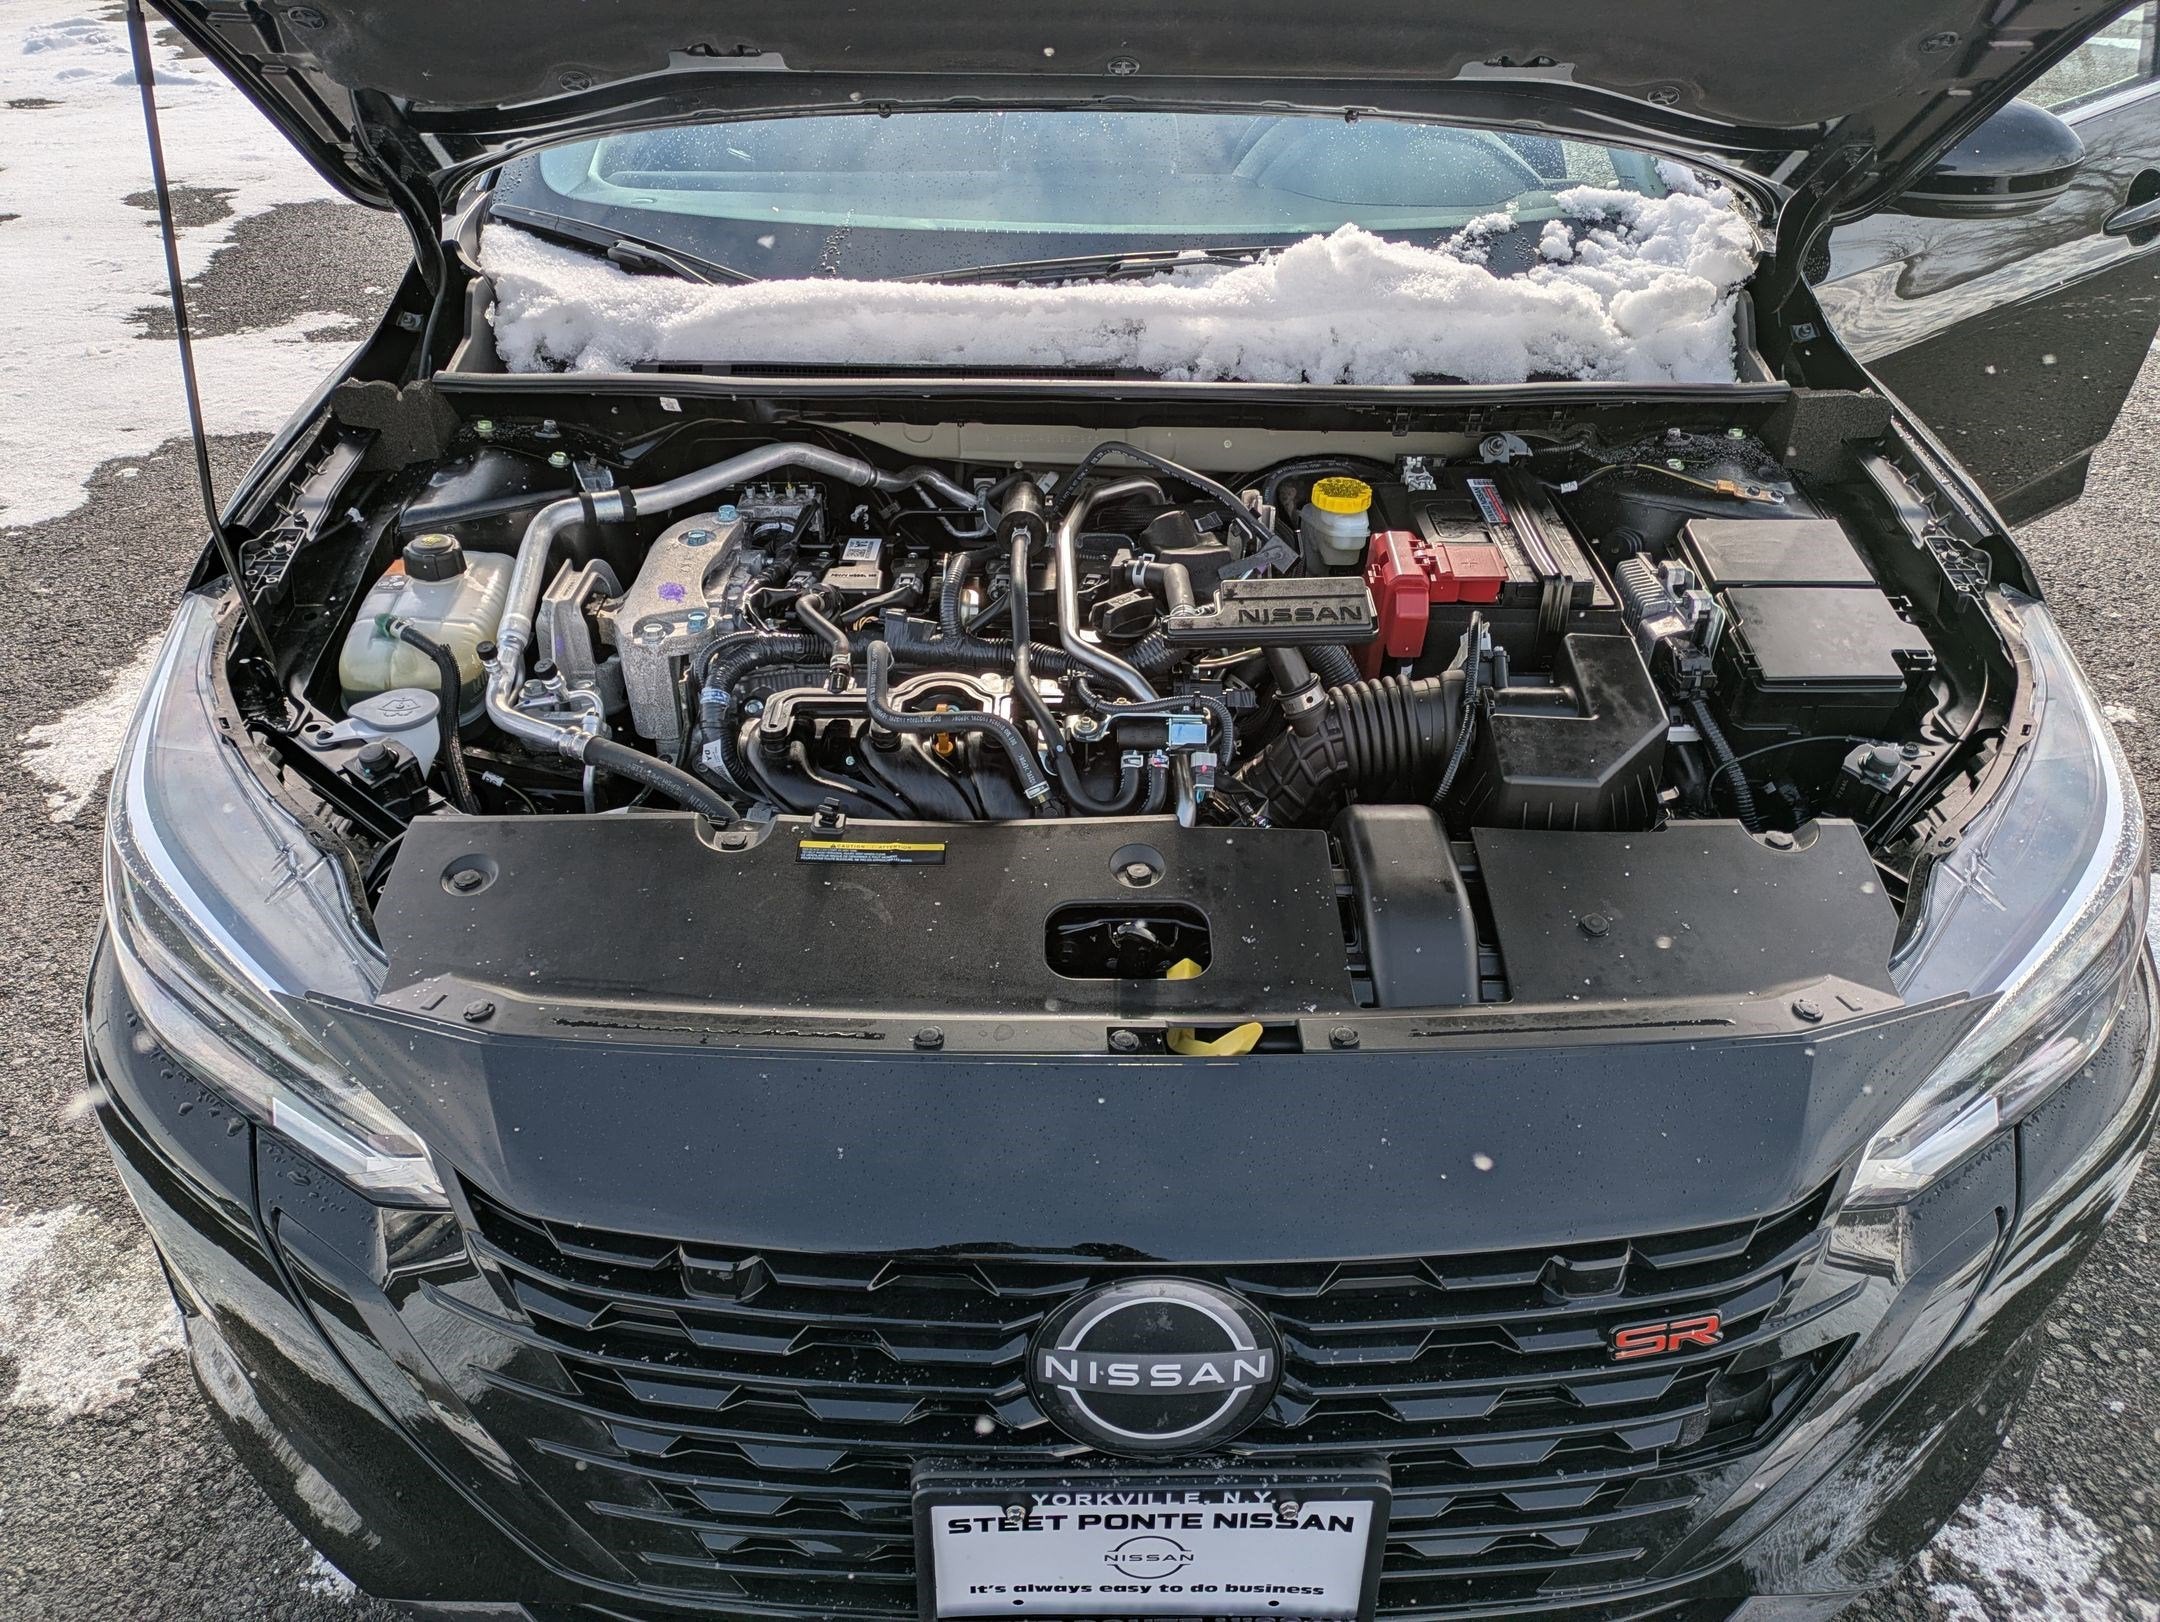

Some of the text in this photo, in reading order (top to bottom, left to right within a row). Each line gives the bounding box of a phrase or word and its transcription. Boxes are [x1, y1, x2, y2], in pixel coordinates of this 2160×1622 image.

[1238, 606, 1363, 623] NISSAN
[1614, 1314, 1720, 1361] SR
[1045, 1354, 1266, 1387] NISSAN
[1031, 1491, 1210, 1506] YORKVILLE,
[947, 1512, 1355, 1534] STEET PONTE NISSAN
[1103, 1554, 1195, 1562] NISSAN
[969, 1583, 1325, 1595] It's always easy to do business
